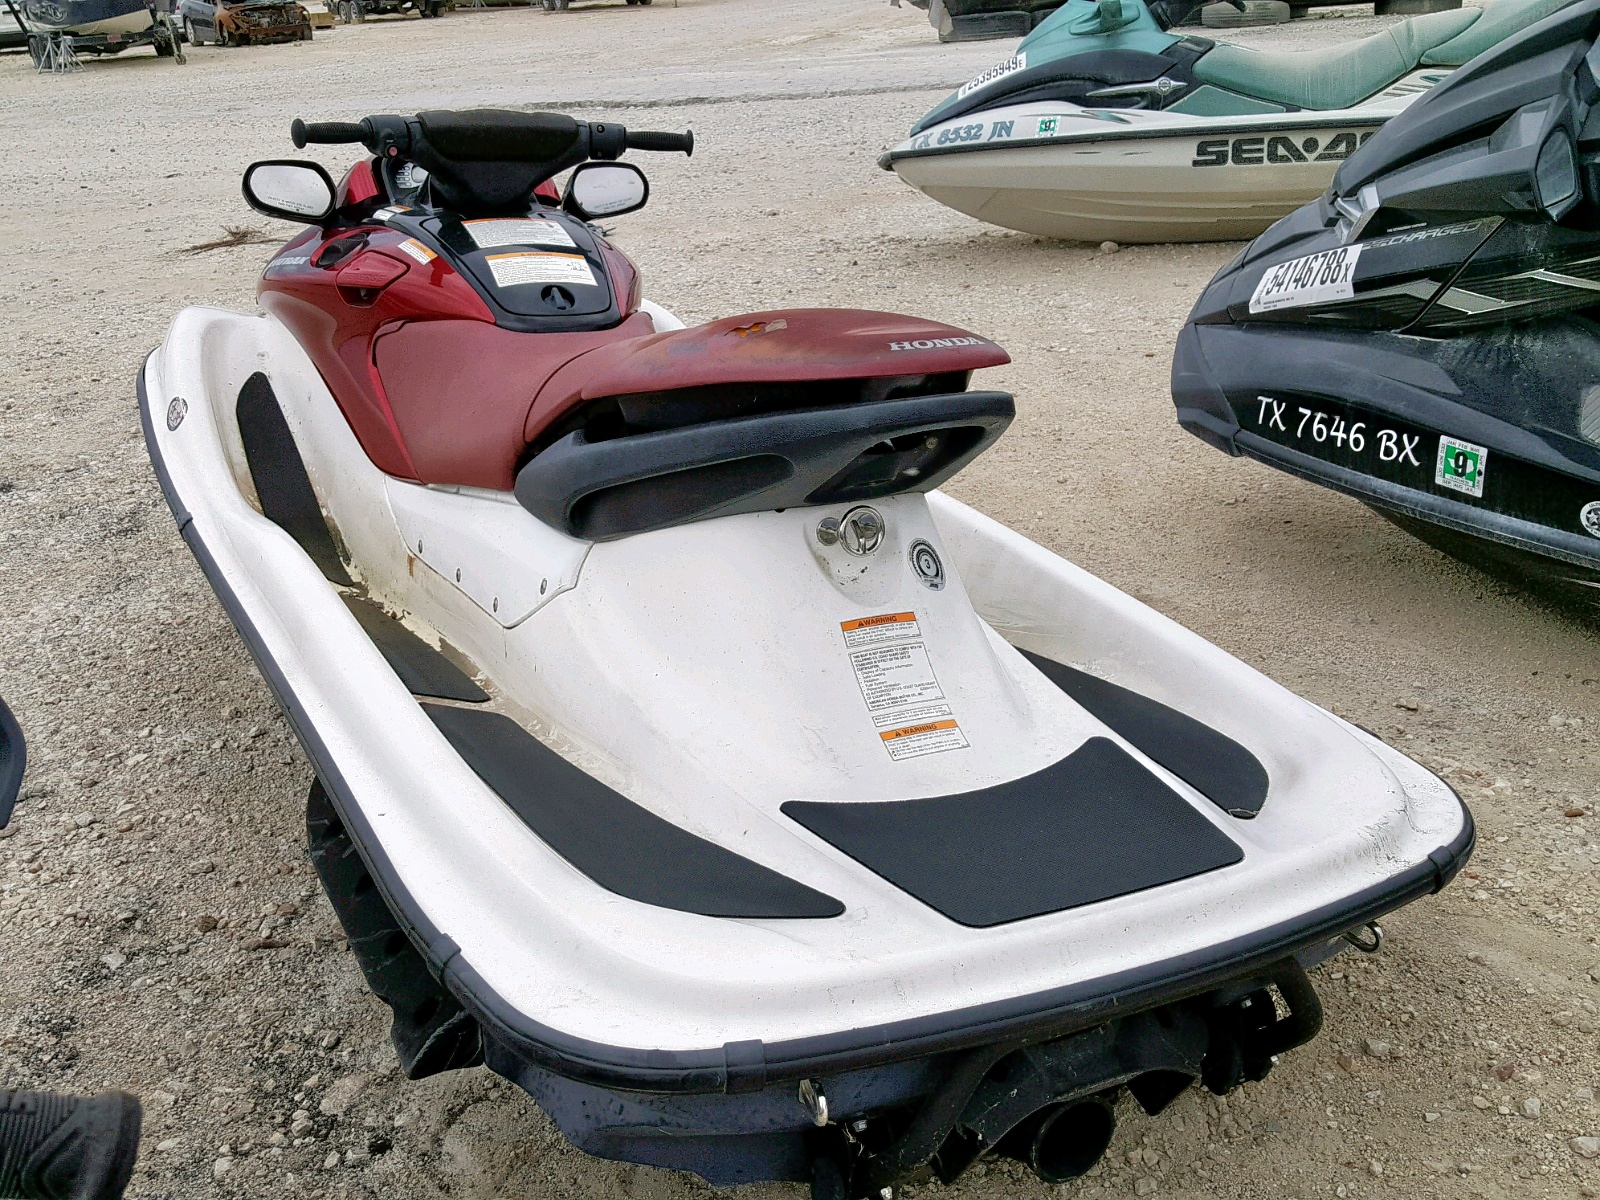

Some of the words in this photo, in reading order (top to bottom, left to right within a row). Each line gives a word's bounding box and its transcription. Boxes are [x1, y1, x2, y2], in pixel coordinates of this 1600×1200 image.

[937, 123, 984, 146] 8532
[987, 120, 1015, 142] JN
[887, 336, 986, 351] HONDA
[1257, 395, 1287, 431] TX
[1297, 406, 1366, 452] 7646
[1376, 429, 1421, 467] BX
[1453, 450, 1468, 478] 9
[924, 558, 931, 570] 3
[863, 616, 898, 626] WARNING
[902, 724, 938, 735] WARNING
